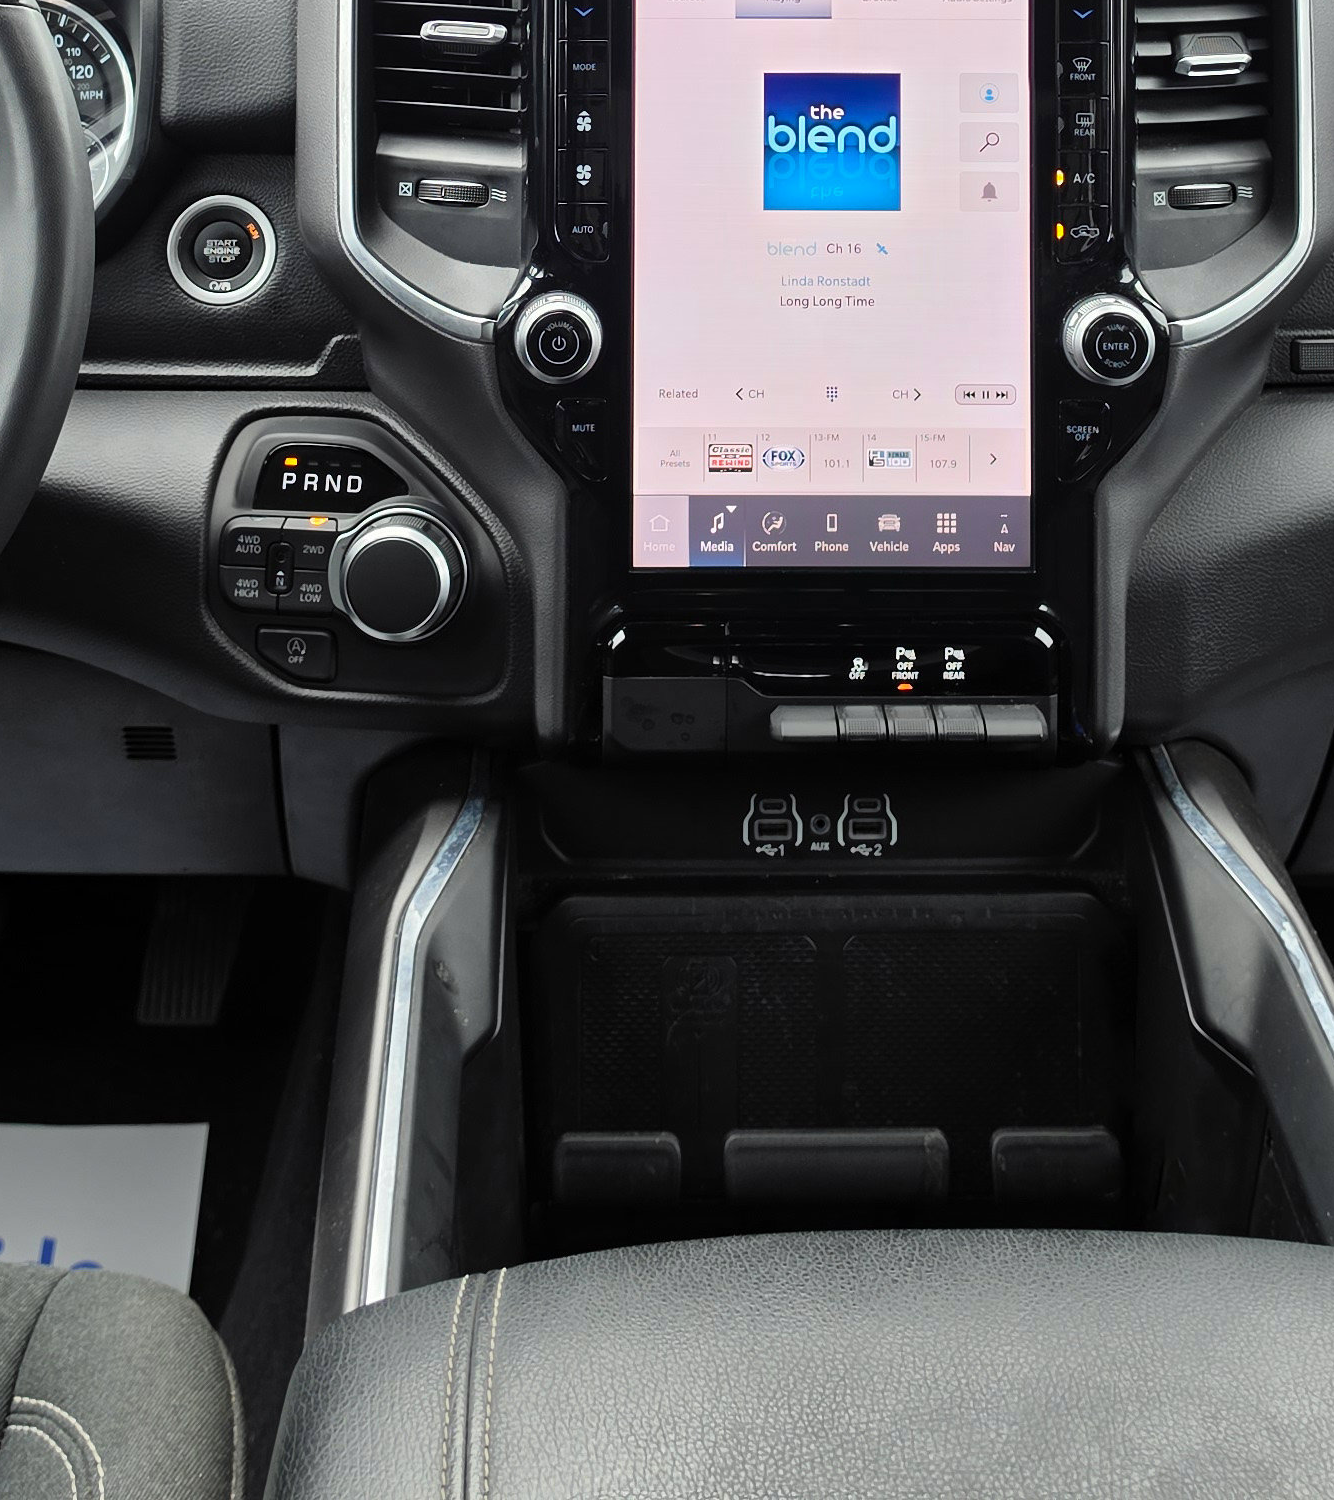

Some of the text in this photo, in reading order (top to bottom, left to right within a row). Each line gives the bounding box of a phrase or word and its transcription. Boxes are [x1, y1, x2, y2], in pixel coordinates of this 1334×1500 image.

[66, 48, 81, 57] 110
[69, 65, 94, 80] 120
[572, 63, 596, 72] MODE
[1069, 73, 1097, 81] FRONT
[79, 90, 103, 101] MPH
[809, 105, 845, 120] the
[768, 115, 898, 154] blend
[1074, 128, 1096, 136] REAR
[1073, 173, 1096, 184] A/C
[572, 225, 594, 234] AUTO
[206, 239, 238, 247] START
[203, 246, 241, 255] ENGINE
[766, 241, 862, 258] blend Ch 16
[780, 275, 871, 288] Linda Ronstadt
[780, 295, 876, 310] Long Long Time
[545, 321, 574, 333] VOLUME
[1103, 342, 1130, 351] ENTER
[1103, 358, 1131, 369] SCROLL
[658, 388, 699, 400] Related
[748, 389, 765, 400] CH
[892, 389, 909, 401] CH
[571, 423, 596, 433] MUTE
[1067, 425, 1100, 434] SCREEN
[707, 434, 717, 442] 11
[761, 434, 771, 442] 12
[813, 434, 840, 442] 13-FM
[867, 434, 877, 442] 14
[920, 434, 946, 442] 15-FM
[1074, 433, 1091, 442] OFF
[669, 450, 681, 458] All
[712, 444, 751, 454] Classic
[771, 449, 796, 461] FOX
[660, 459, 691, 469] Presets
[711, 458, 751, 467] REWIND
[824, 459, 850, 469] 101.1
[930, 459, 957, 469] 107.9
[237, 534, 261, 545] 4WD
[235, 545, 262, 554] AUTO
[302, 545, 325, 555] 2WD
[643, 541, 676, 553] Home
[700, 541, 734, 553] Media
[752, 541, 797, 553] Comfort
[814, 541, 849, 553] Phone
[869, 541, 909, 553] Vehicle
[932, 541, 961, 555] Apps
[993, 541, 1015, 553] Nav
[236, 578, 259, 588] 4WD
[299, 583, 322, 593] 4WD
[234, 588, 259, 598] HIGH
[299, 593, 322, 603] LOW
[288, 655, 305, 664] OFF
[896, 661, 914, 670] OFF
[945, 661, 963, 670] OFF
[848, 671, 866, 680] OFF
[891, 671, 919, 680] FRONT
[942, 671, 965, 680] REAR
[810, 841, 830, 851] AUX
[873, 843, 883, 857] 2
